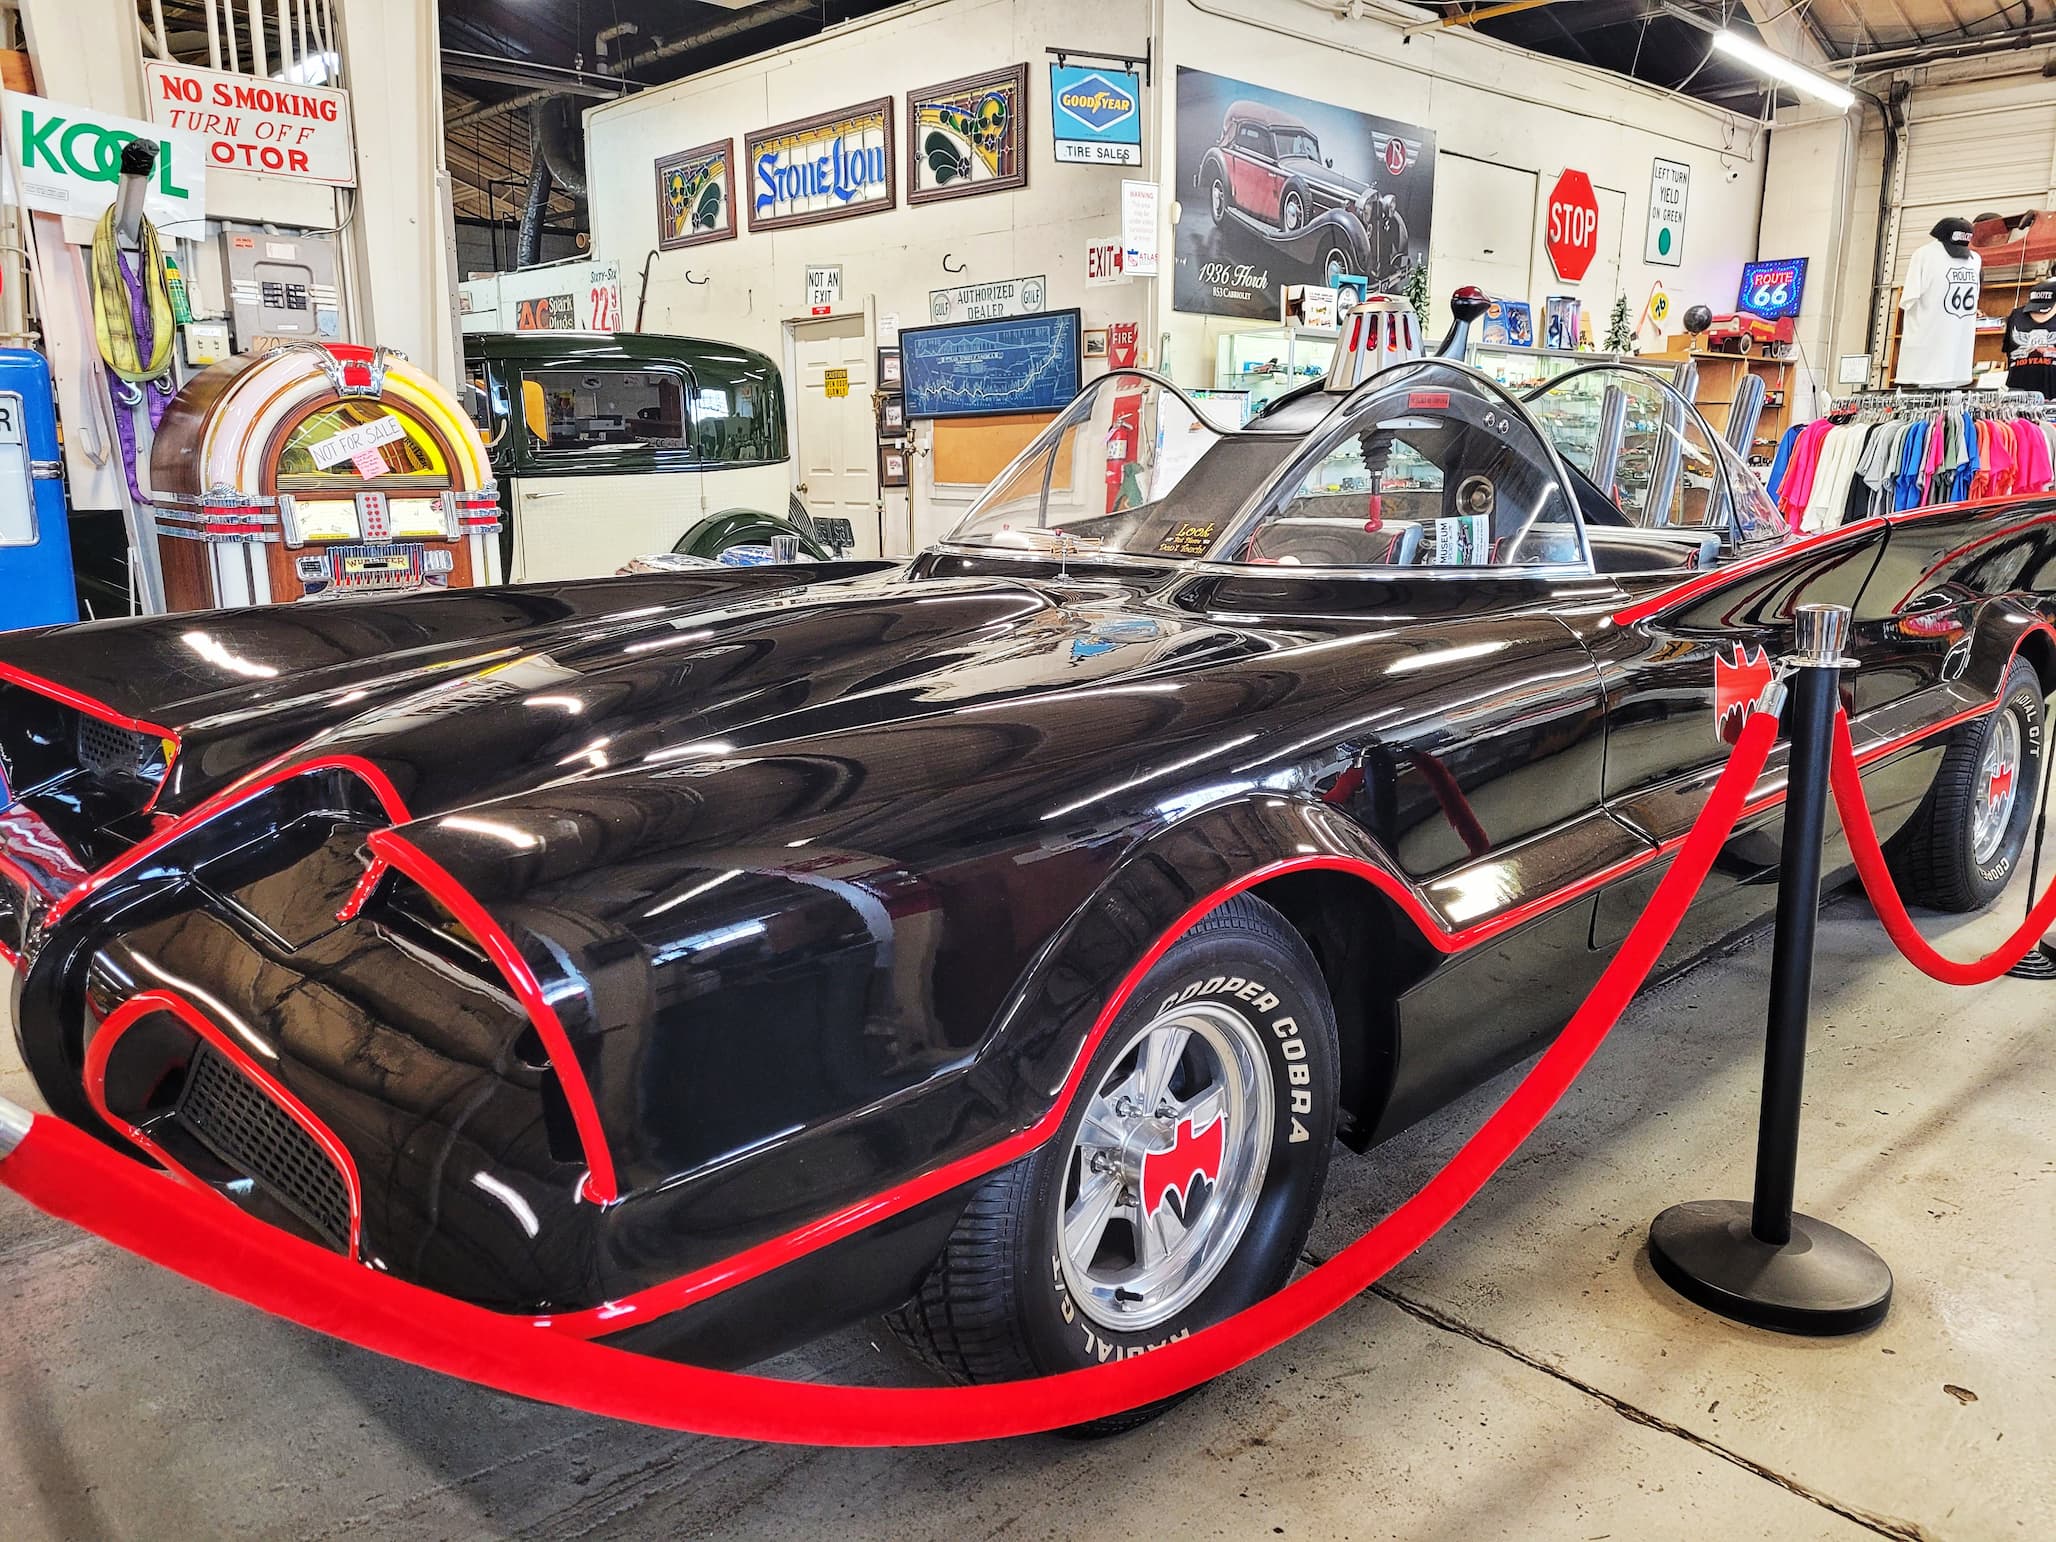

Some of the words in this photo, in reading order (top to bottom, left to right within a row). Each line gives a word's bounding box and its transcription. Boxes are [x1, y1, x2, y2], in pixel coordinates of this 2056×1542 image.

[160, 75, 203, 103] NO
[213, 83, 337, 122] SMOKING
[1062, 93, 1130, 112] GOODYEAR
[170, 110, 241, 136] TURN
[255, 121, 315, 145] OFF
[211, 141, 310, 172] OTOR
[1066, 145, 1091, 158] TIRE
[1097, 147, 1130, 160] SALES
[1654, 166, 1670, 181] LEFT
[1671, 169, 1687, 184] TURN
[1660, 186, 1679, 204] YIELD
[1550, 201, 1596, 248] STOP
[1652, 206, 1661, 219] ON
[1663, 208, 1683, 223] GREEN
[1089, 245, 1114, 278] EXIT
[808, 271, 825, 288] NOT
[827, 271, 839, 287] AN
[1199, 262, 1231, 285] 1936
[1755, 271, 1794, 286] ROUTE
[1952, 271, 1976, 282] ROUTE
[814, 290, 832, 304] EXIT
[957, 284, 1014, 305] AUTHORIZED
[1212, 286, 1223, 298] 853
[1754, 284, 1788, 307] 66
[1951, 286, 1975, 311] 66
[518, 298, 549, 330] AC
[549, 297, 574, 317] Spark
[591, 286, 612, 332] 22
[934, 302, 949, 316] GULF
[967, 303, 1004, 320] DEALER
[1023, 289, 1040, 304] GULF
[1655, 297, 1666, 317] 76
[1112, 331, 1133, 345] FIRE
[313, 441, 339, 464] NOT
[339, 432, 363, 453] FOR
[366, 419, 400, 444] SALE
[1176, 522, 1216, 538] Look
[1440, 522, 1449, 563] MUSEUM
[1155, 976, 1280, 1018] COOPER
[1272, 1016, 1312, 1143] COBRA
